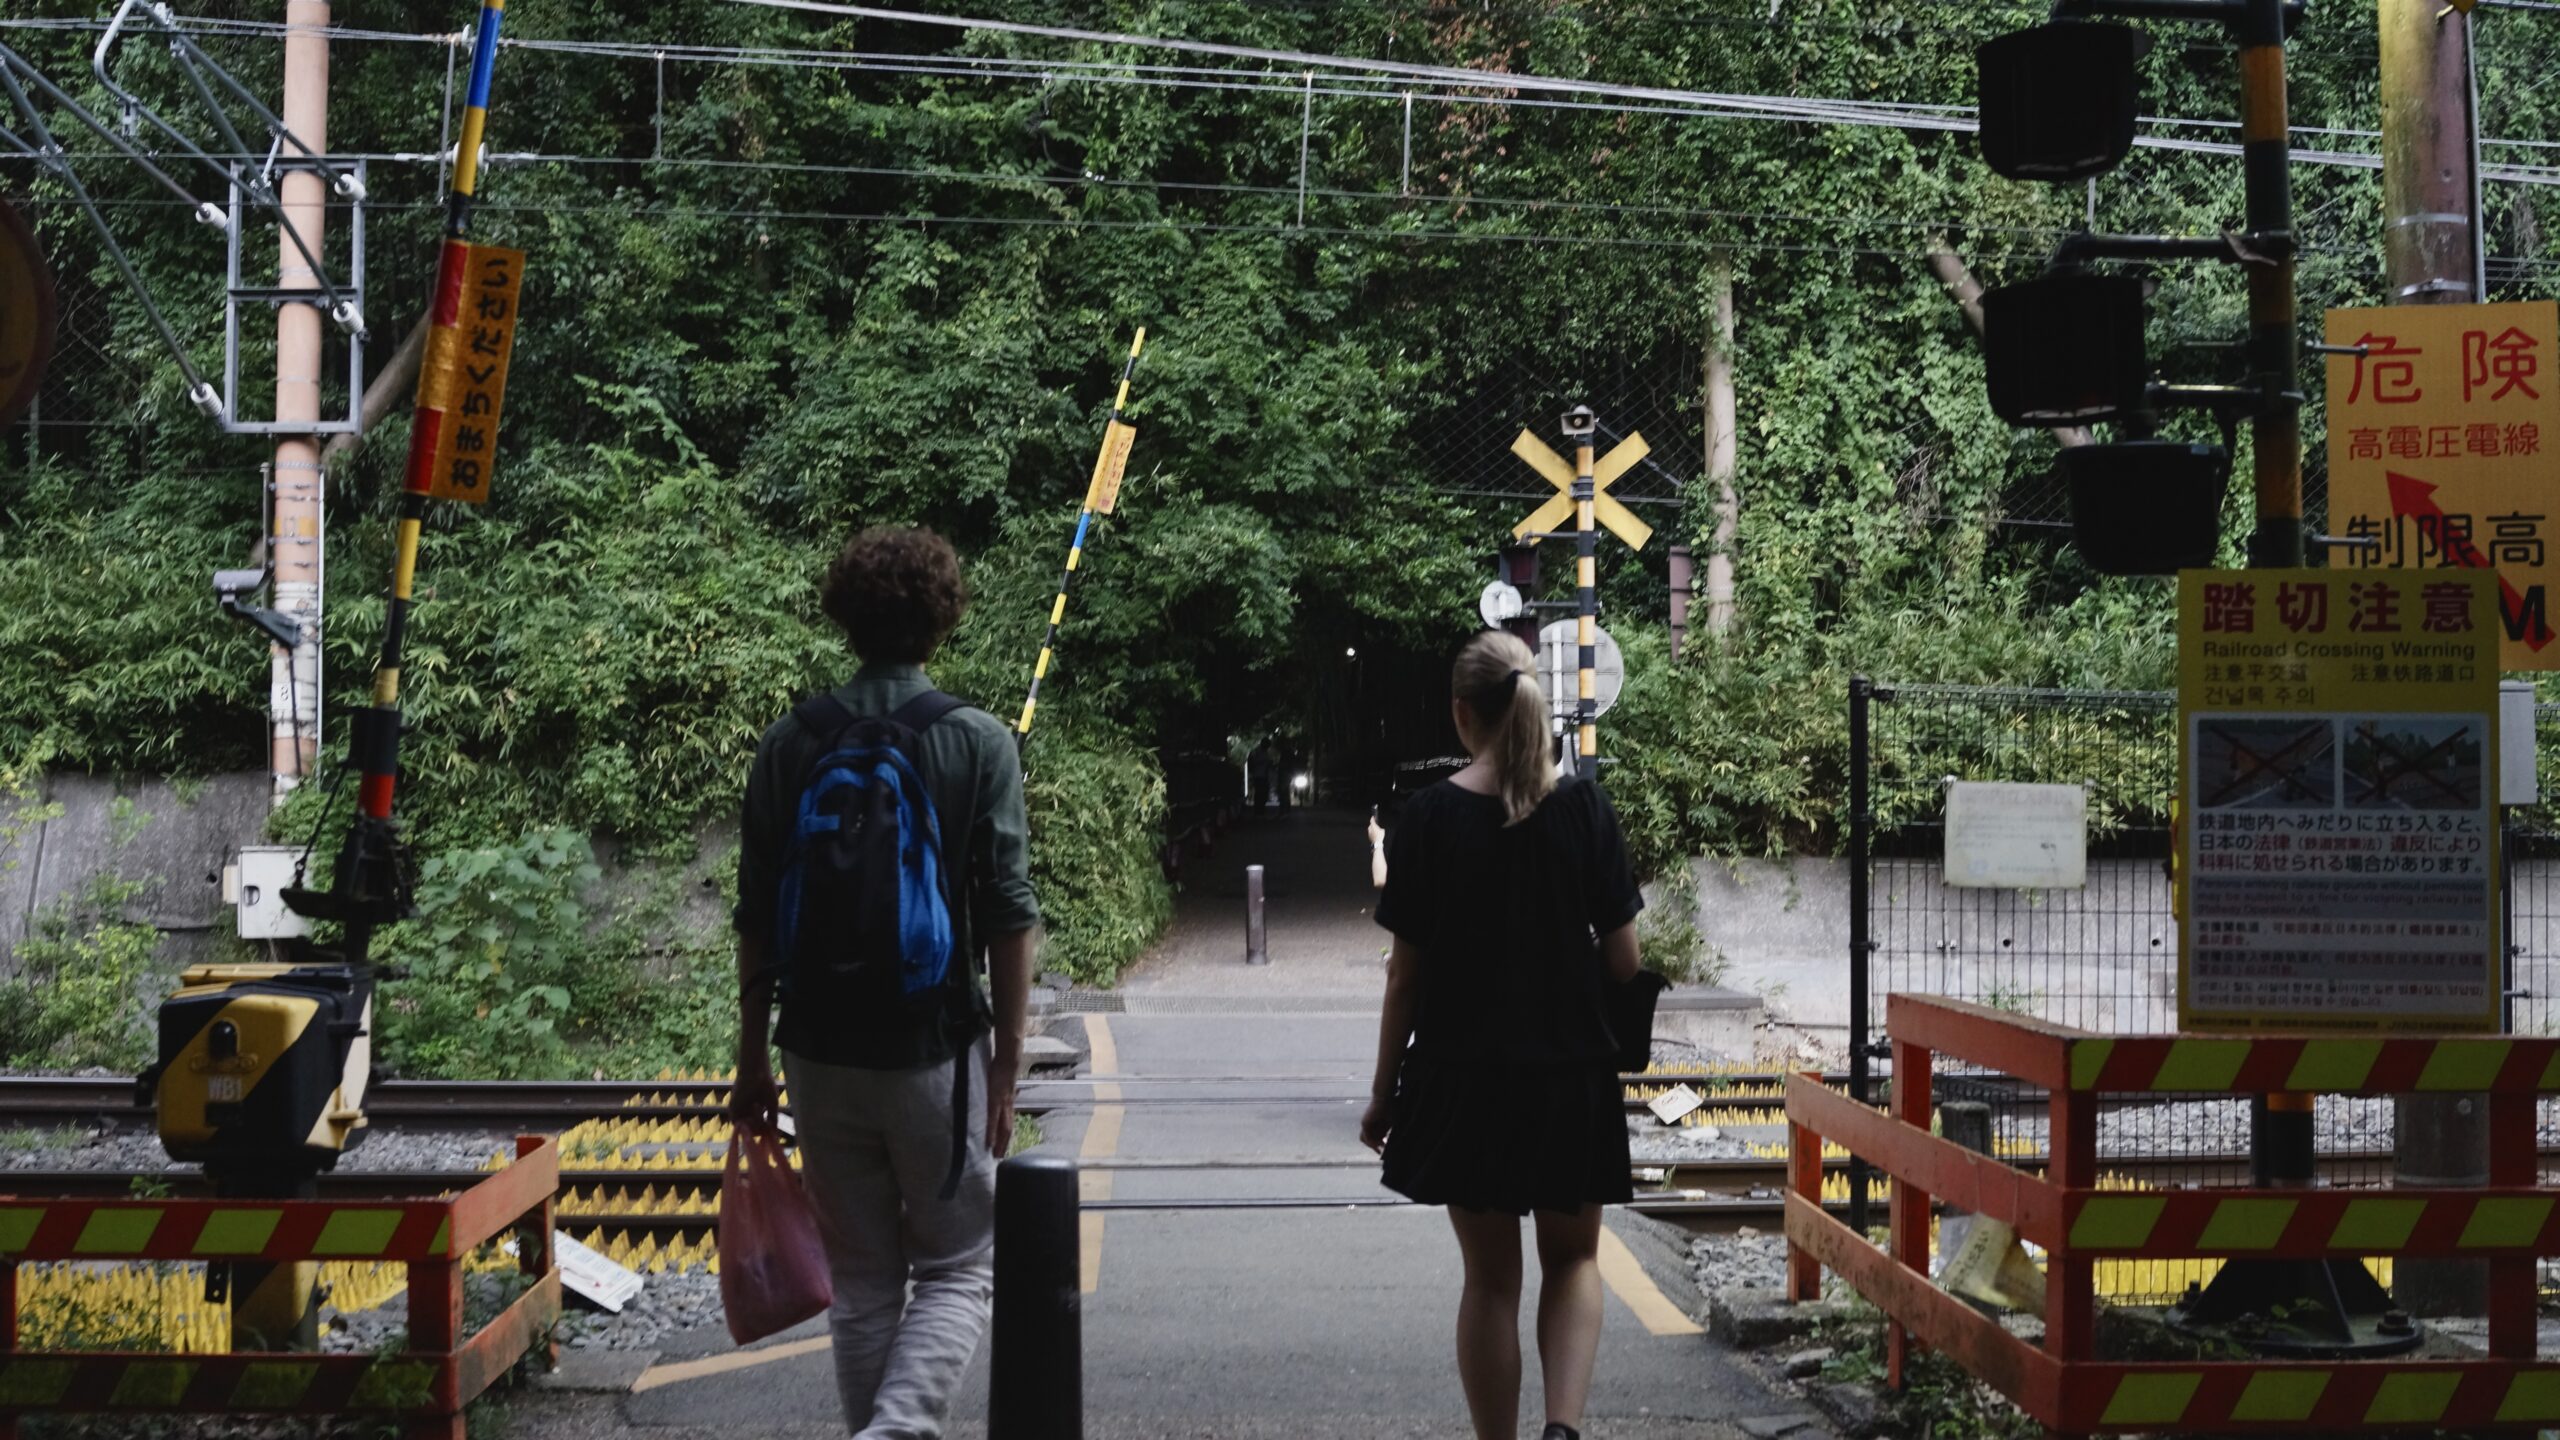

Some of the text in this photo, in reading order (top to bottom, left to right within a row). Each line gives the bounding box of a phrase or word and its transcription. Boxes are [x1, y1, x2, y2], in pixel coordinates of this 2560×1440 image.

[450, 258, 510, 489] おまちください
[2347, 326, 2540, 404] 危険
[2348, 421, 2540, 461] 高電圧電線
[2202, 581, 2475, 634] 踏切注意
[2203, 641, 2475, 661] Railroad Crossing Warning
[2343, 893, 2359, 903] for
